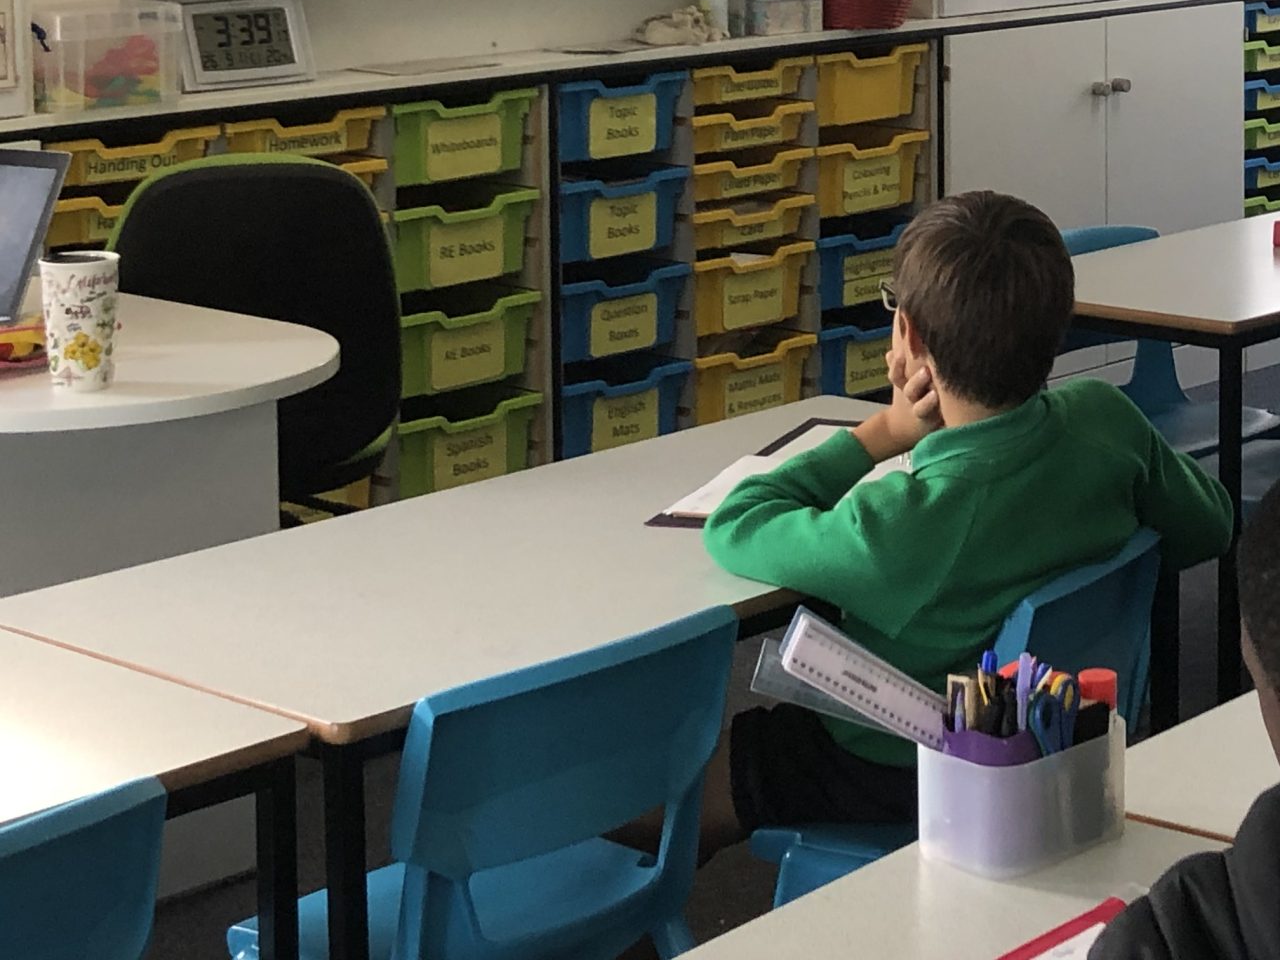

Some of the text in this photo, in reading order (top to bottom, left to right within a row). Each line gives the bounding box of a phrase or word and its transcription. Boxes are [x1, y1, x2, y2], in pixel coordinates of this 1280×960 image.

[212, 12, 274, 49] 3:39
[608, 105, 639, 120] Topic
[268, 129, 343, 152] Homework
[606, 126, 640, 141] Books
[431, 136, 498, 155] Whiteboards
[87, 153, 178, 176] Handing Out
[609, 203, 639, 218] Topic
[607, 224, 641, 240] Books
[458, 242, 496, 257] Books
[600, 303, 649, 324] Question
[608, 328, 640, 342] Boxes
[459, 344, 492, 359] Books
[612, 423, 641, 438] Mats
[452, 460, 491, 478] Books
